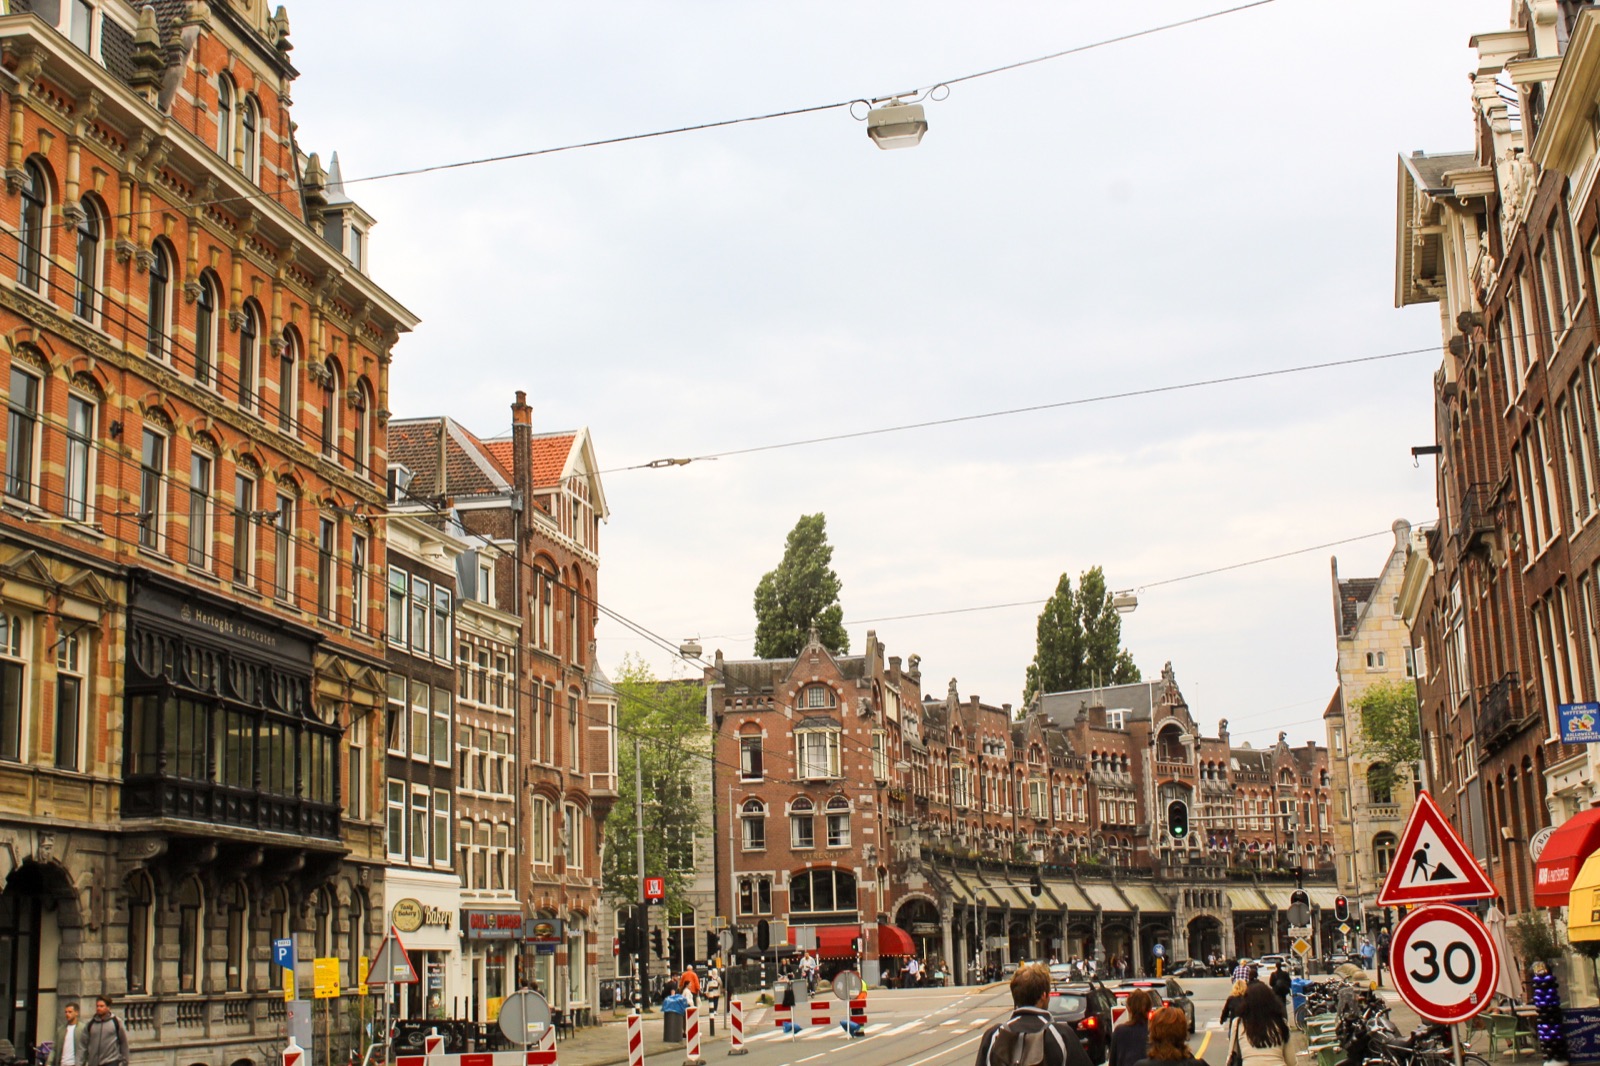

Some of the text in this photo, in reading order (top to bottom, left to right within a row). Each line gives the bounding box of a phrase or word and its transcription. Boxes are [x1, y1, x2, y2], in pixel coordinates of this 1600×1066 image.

[195, 609, 276, 647] Hertoghs advocaten
[423, 906, 453, 929] Bakery
[470, 914, 522, 929] GRILL BURGER
[279, 948, 287, 960] P
[1409, 940, 1476, 985] 30
